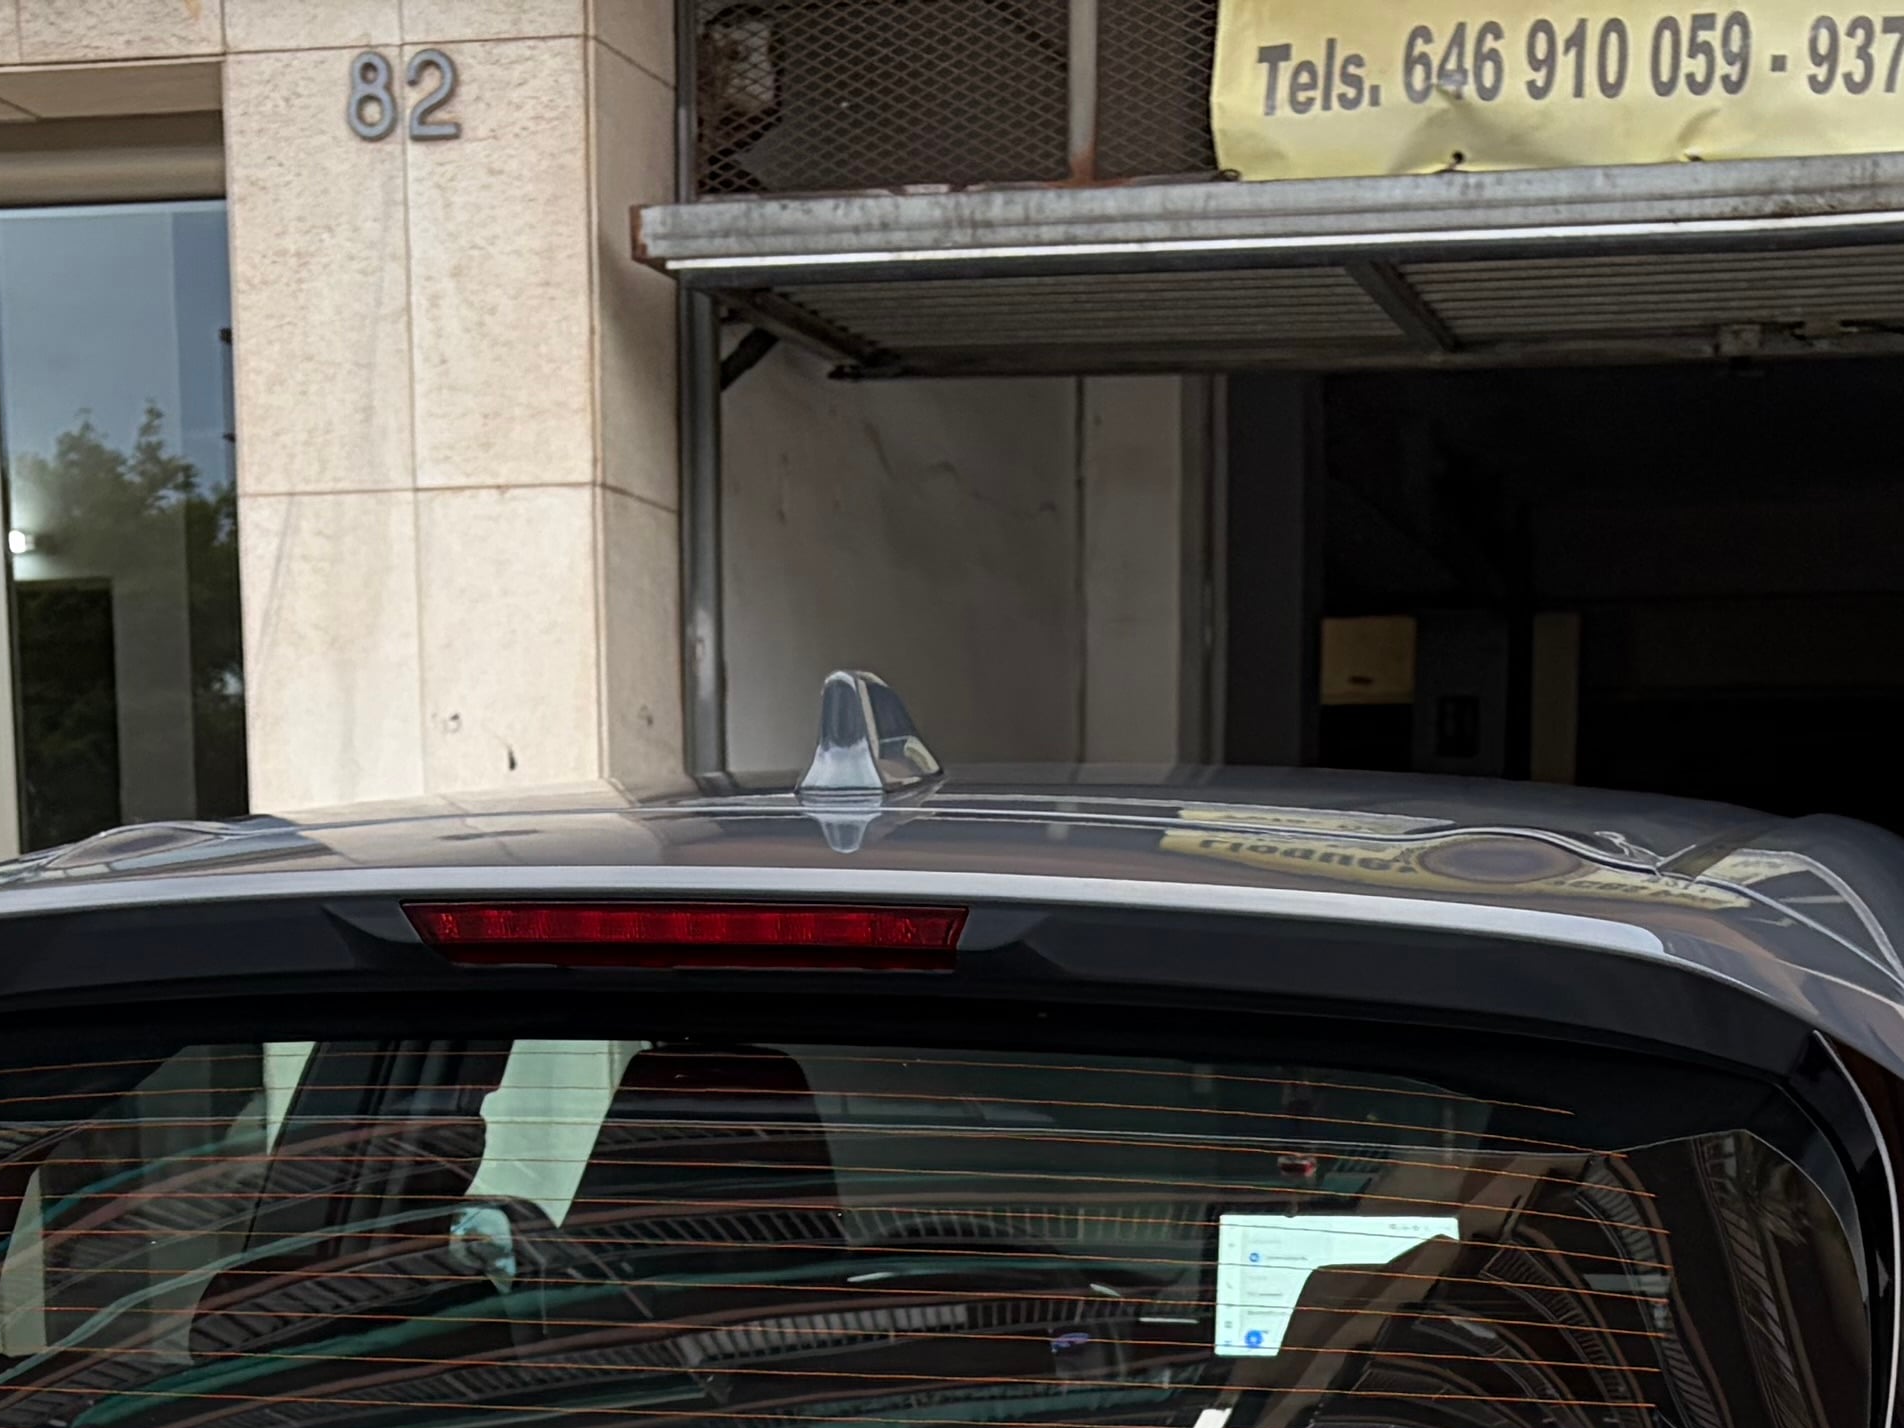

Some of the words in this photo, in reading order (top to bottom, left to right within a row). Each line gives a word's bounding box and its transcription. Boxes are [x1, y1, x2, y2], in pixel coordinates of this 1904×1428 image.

[347, 48, 462, 142] 82
[1256, 37, 1382, 116] Tels.
[1402, 20, 1505, 104] 646
[1525, 17, 1629, 101] 910
[1650, 10, 1752, 98] 059
